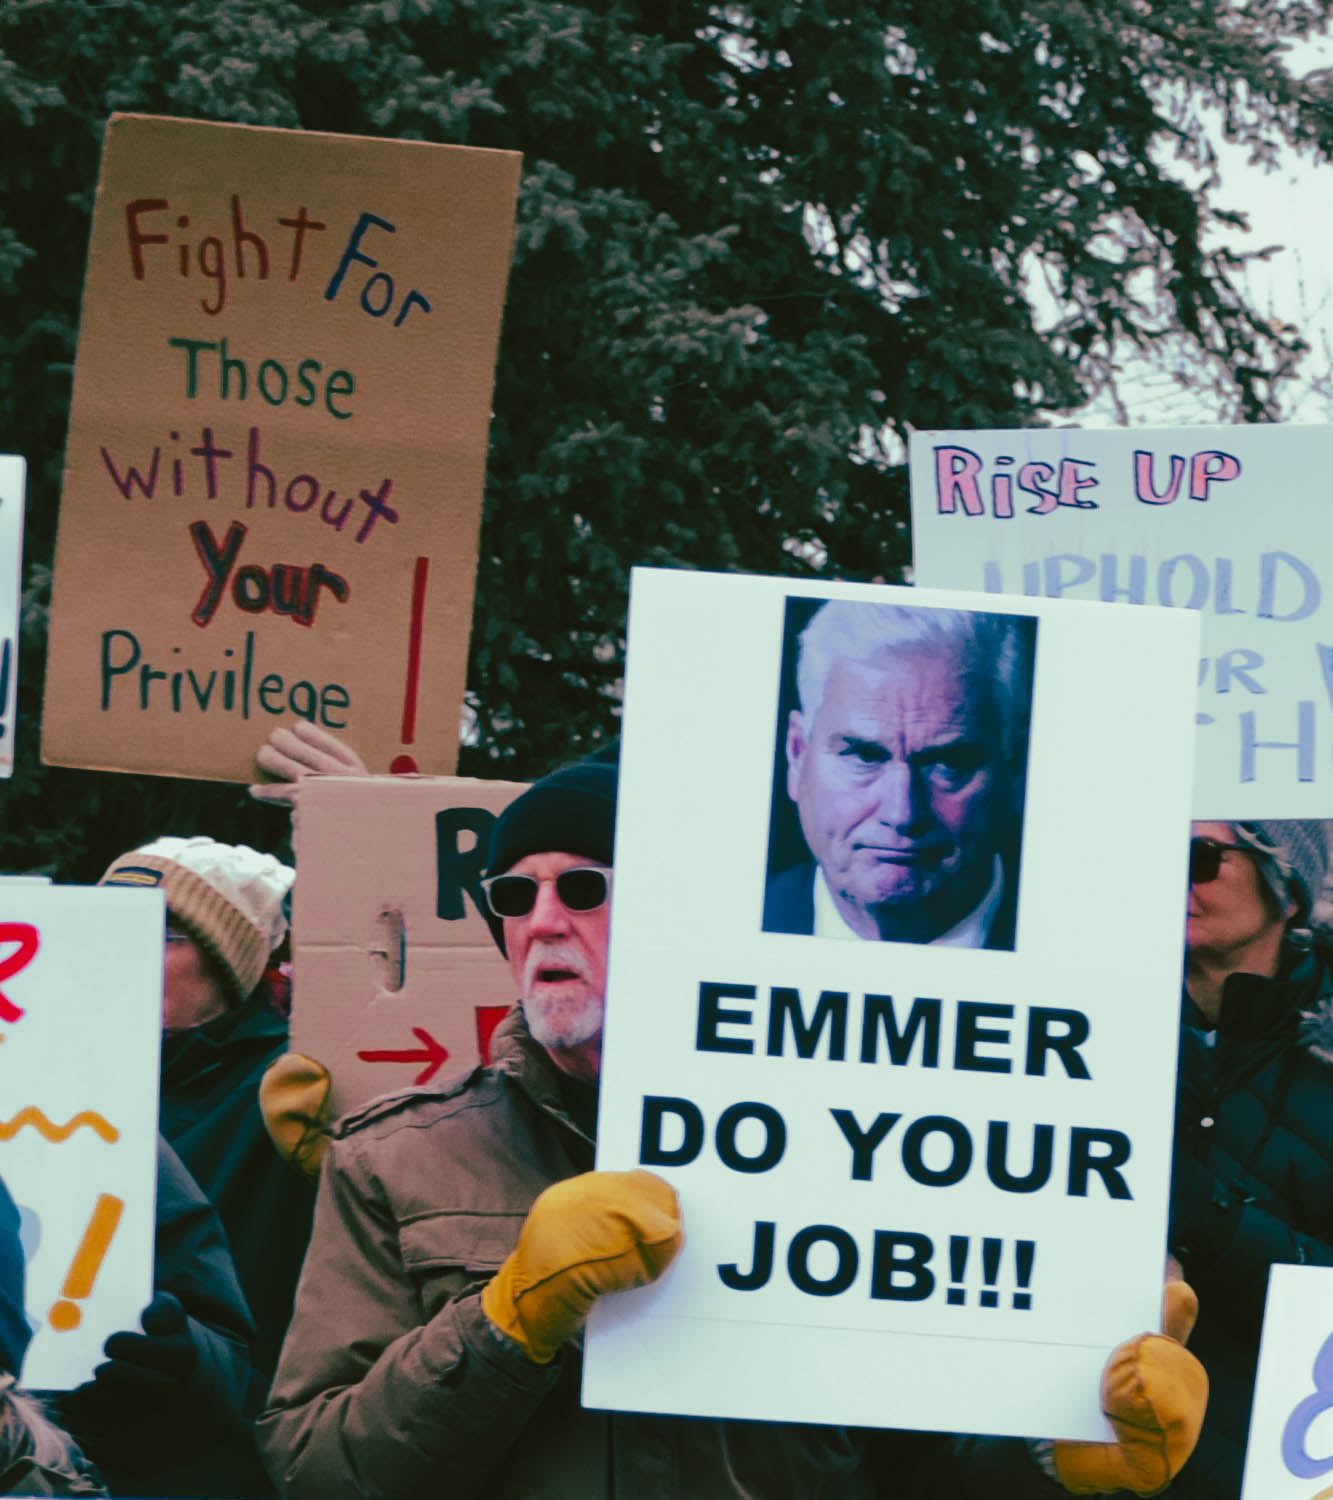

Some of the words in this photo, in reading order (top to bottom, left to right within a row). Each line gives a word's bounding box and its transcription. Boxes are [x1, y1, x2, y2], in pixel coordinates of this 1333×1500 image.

[125, 194, 326, 316] Fight
[324, 212, 432, 327] For
[169, 336, 356, 420] Those
[1134, 449, 1242, 506] UP
[190, 520, 350, 628] Your
[695, 980, 1093, 1081] EMMER
[638, 1094, 788, 1174] DO
[828, 1107, 1135, 1201] YOUR
[716, 1220, 1037, 1312] JOB!!!
